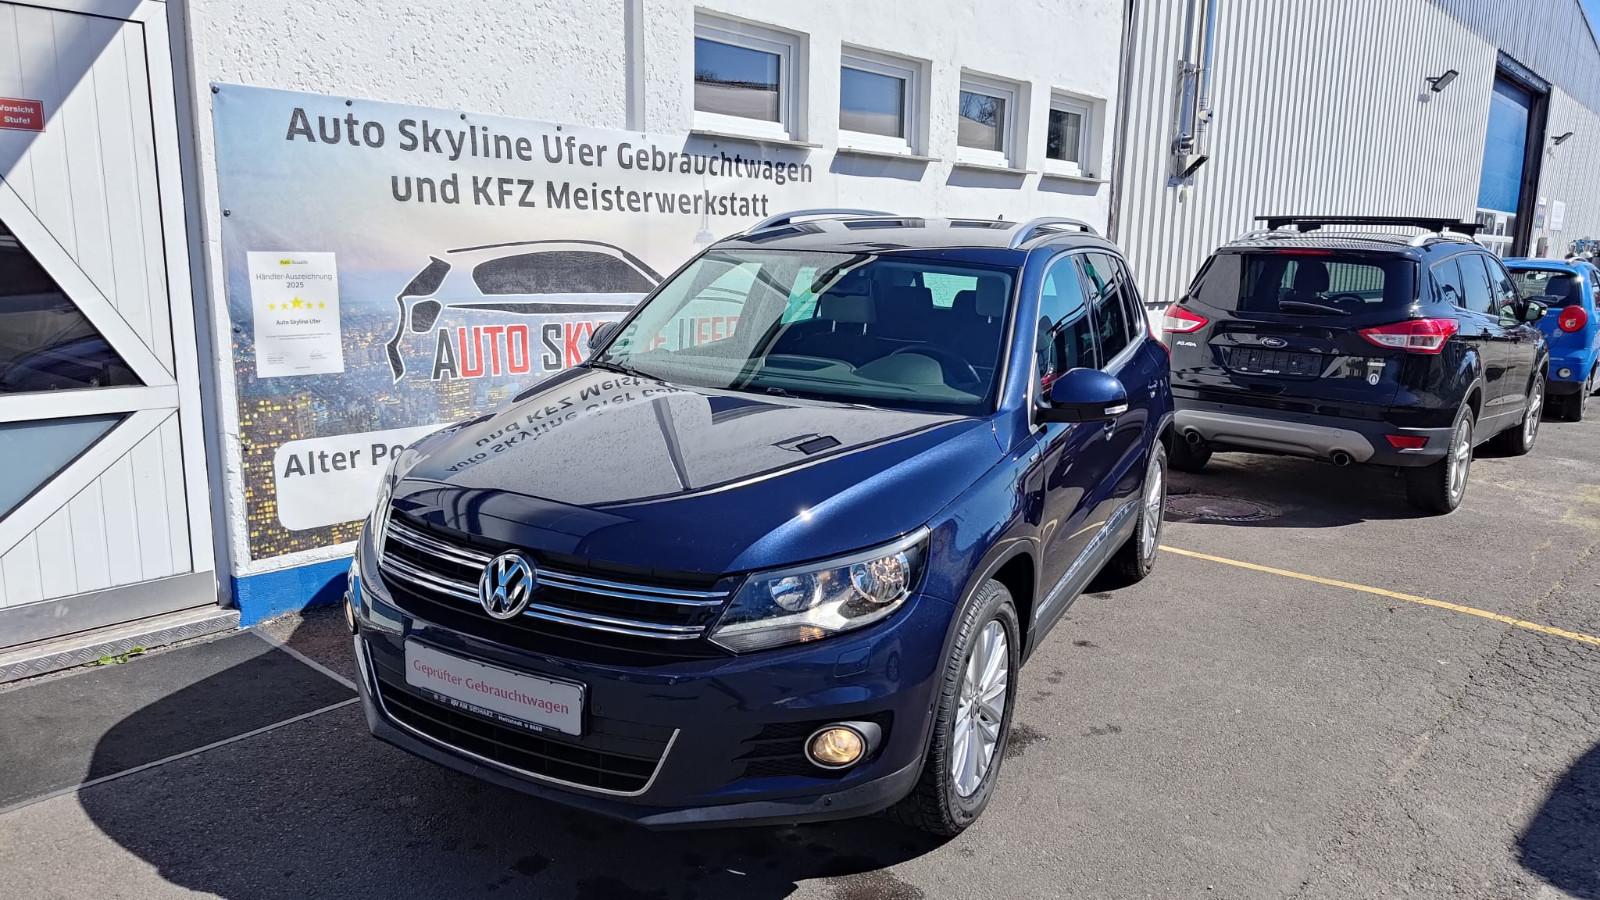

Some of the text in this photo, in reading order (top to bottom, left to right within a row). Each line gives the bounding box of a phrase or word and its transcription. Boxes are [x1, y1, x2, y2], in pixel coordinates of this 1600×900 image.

[286, 107, 812, 186] Auto Skyline Ufer Gebrauchtwagen
[391, 173, 769, 218] und KFZ Meisterwerkstatt
[432, 323, 530, 381] AUTO
[284, 449, 361, 479] Alter
[413, 659, 463, 686] Geprüfter
[465, 677, 570, 715] Gebrauchtwagen
